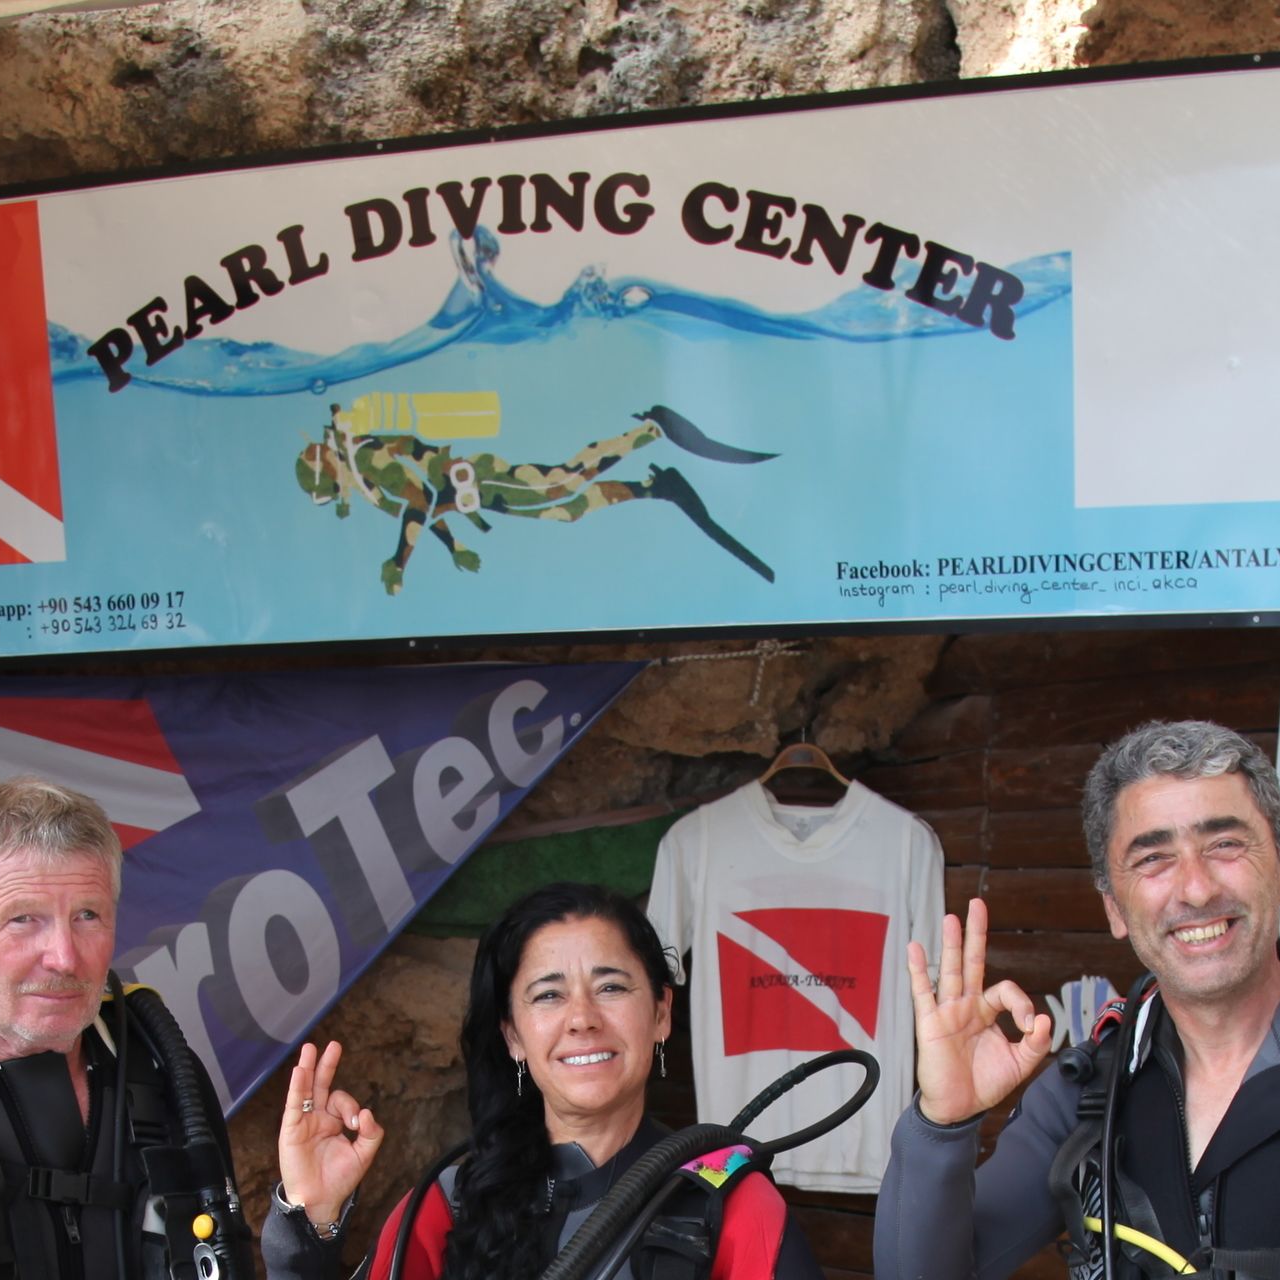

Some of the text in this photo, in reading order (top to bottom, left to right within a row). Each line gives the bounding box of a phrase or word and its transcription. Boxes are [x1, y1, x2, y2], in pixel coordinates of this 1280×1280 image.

[87, 171, 1027, 392] PEARL DIVING CENTER
[836, 559, 931, 580] Facebook:
[37, 597, 68, 615] +90
[73, 595, 102, 613] 543
[107, 594, 135, 612] 660
[141, 592, 160, 610] 09
[167, 591, 185, 609] 17
[40, 619, 70, 635] +90
[73, 617, 102, 634] 543
[108, 614, 136, 632] 324
[142, 613, 158, 630] 69
[166, 612, 186, 629] 32
